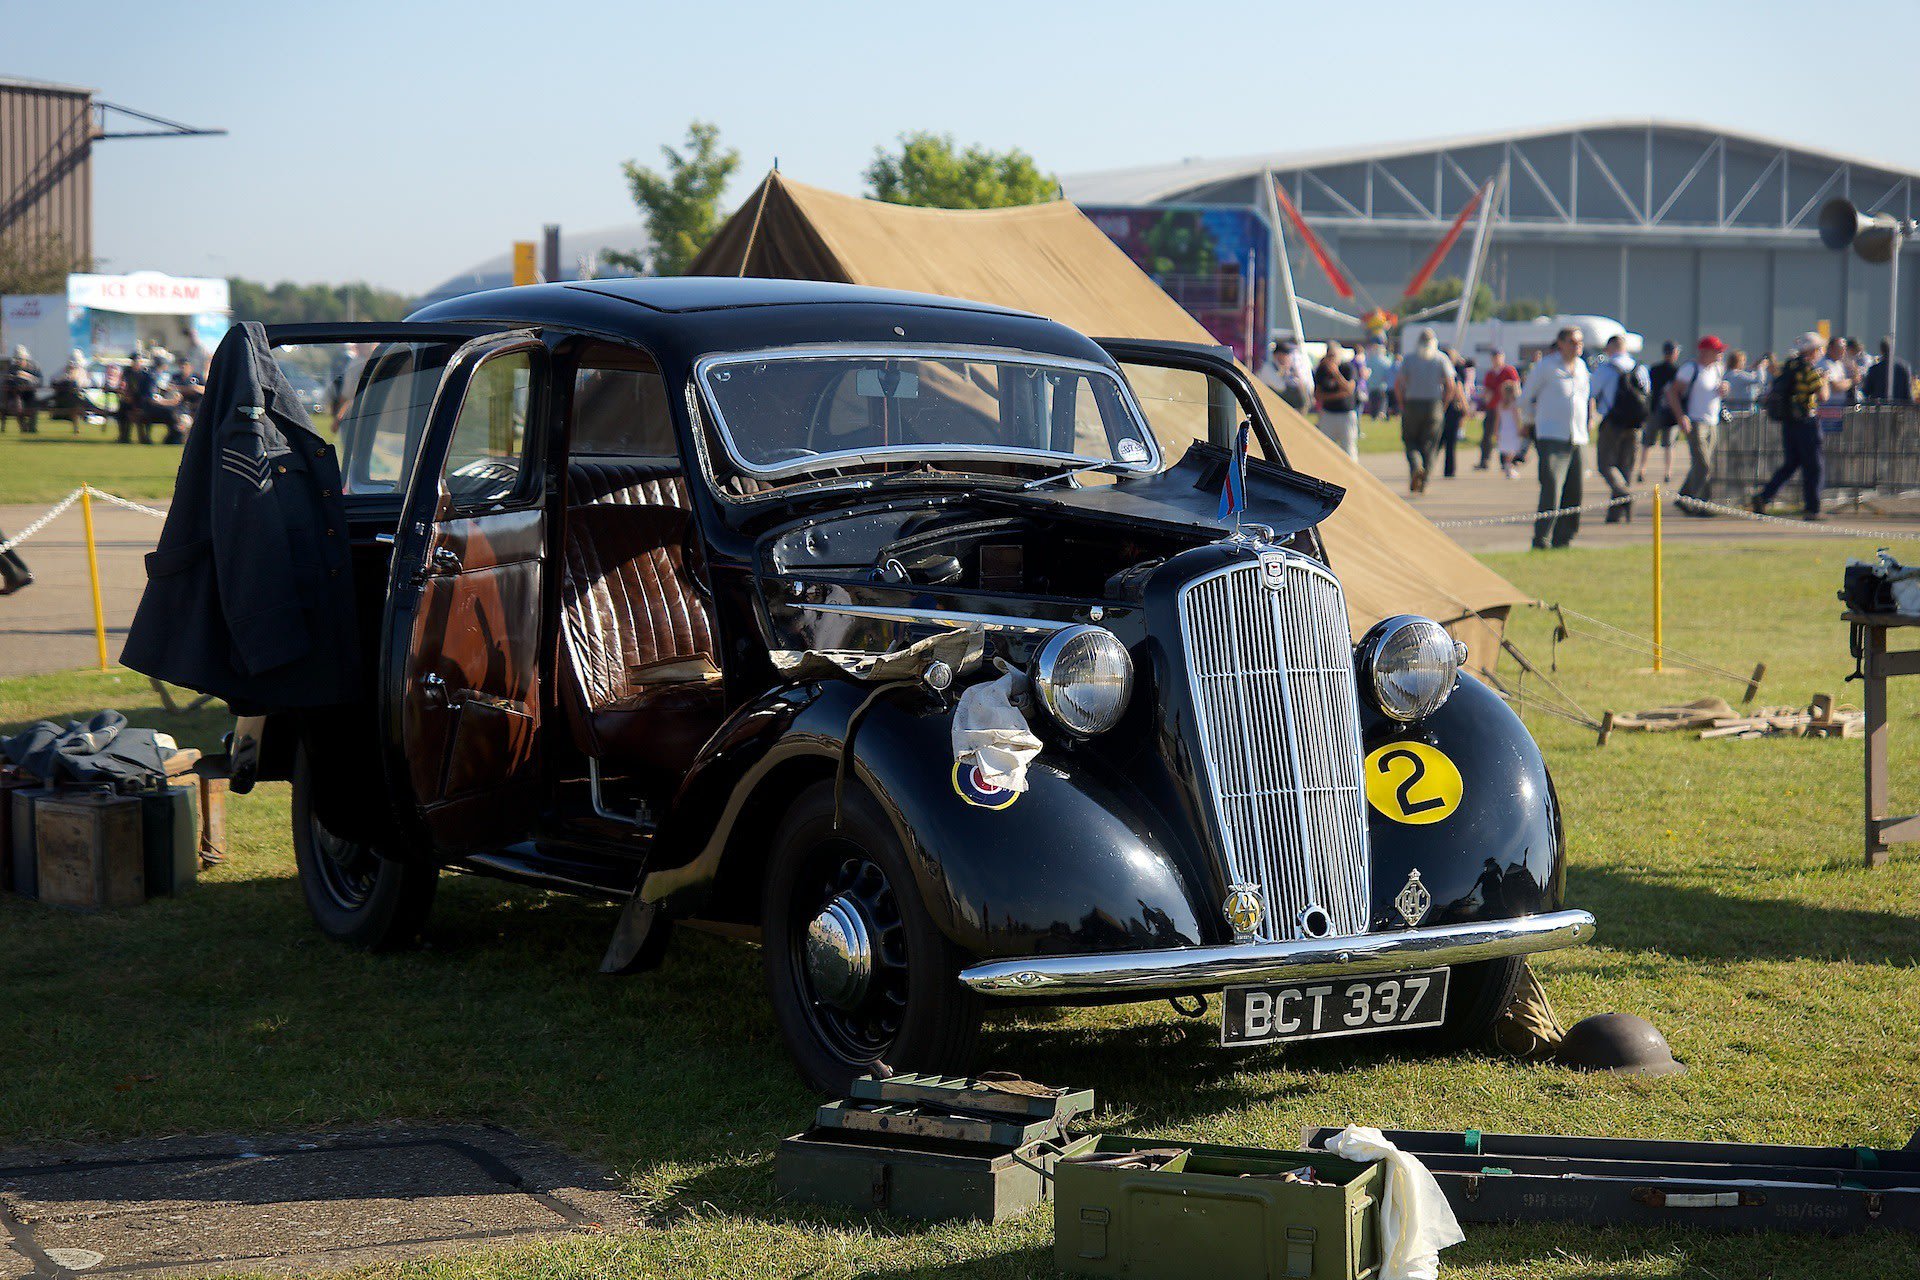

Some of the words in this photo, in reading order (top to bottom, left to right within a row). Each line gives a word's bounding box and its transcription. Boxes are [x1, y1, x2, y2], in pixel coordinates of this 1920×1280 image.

[101, 283, 126, 297] ICE
[136, 284, 201, 299] CREAM
[1377, 749, 1446, 817] 2
[1244, 985, 1333, 1037] BCT
[1342, 977, 1431, 1027] 337
